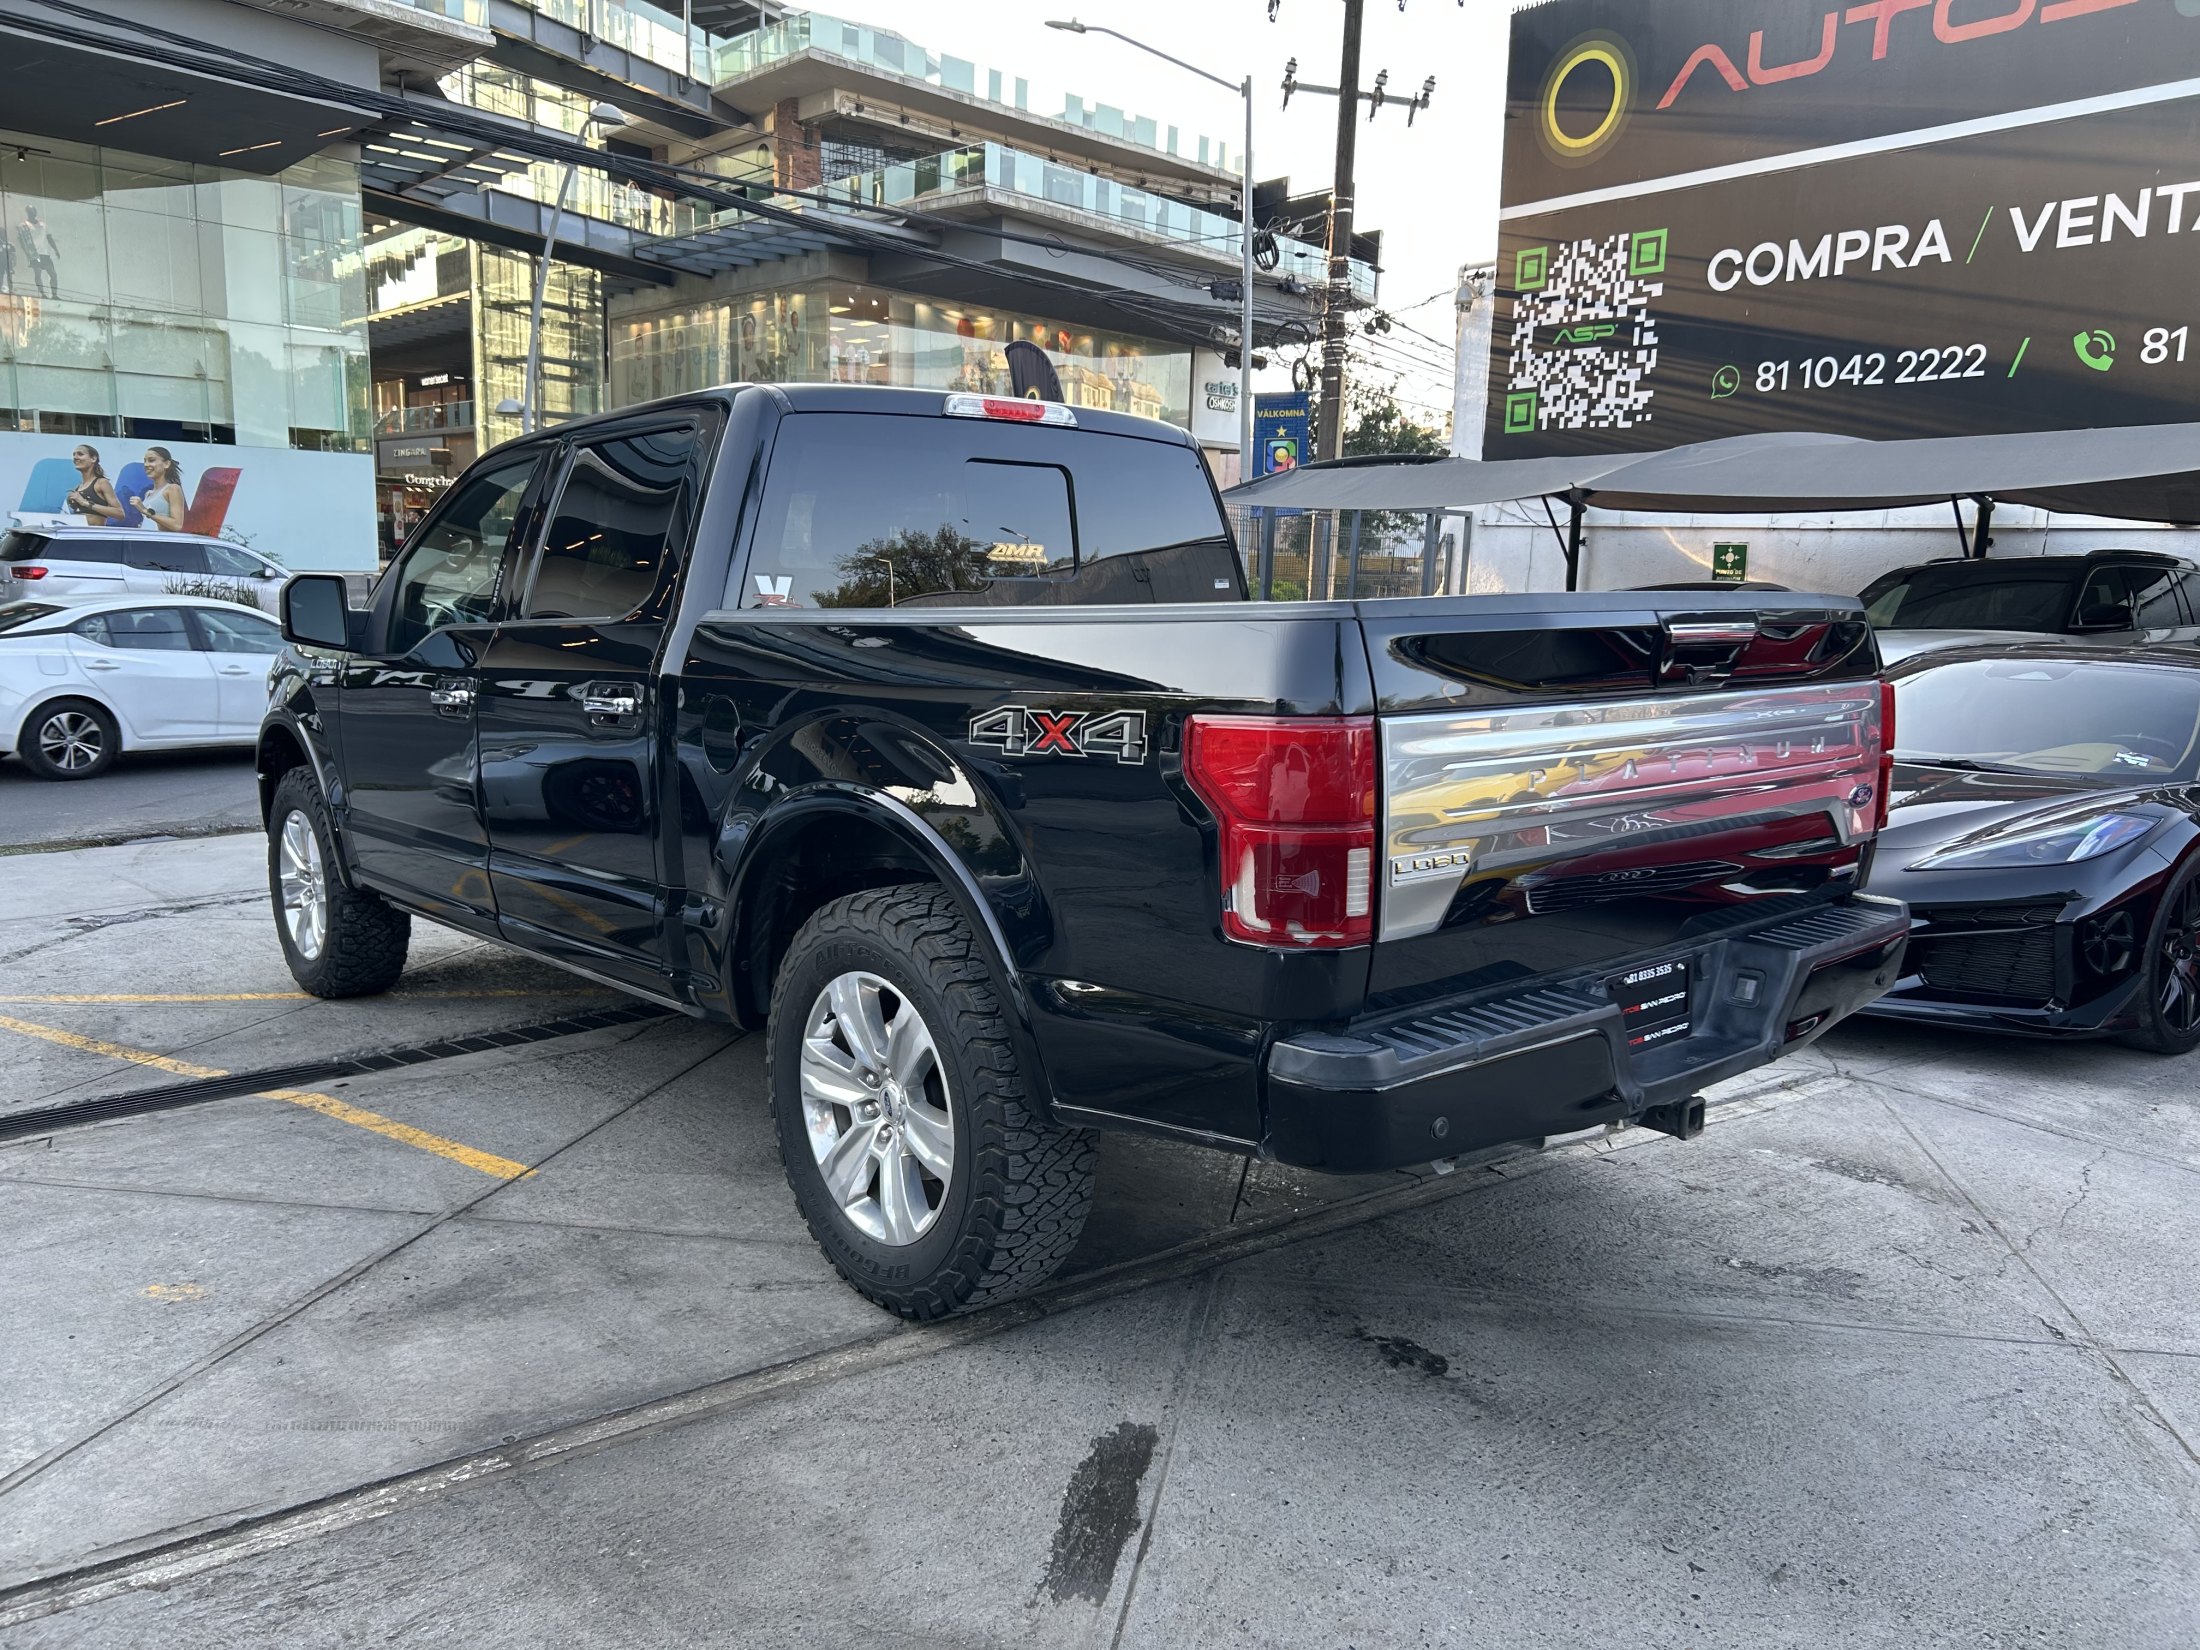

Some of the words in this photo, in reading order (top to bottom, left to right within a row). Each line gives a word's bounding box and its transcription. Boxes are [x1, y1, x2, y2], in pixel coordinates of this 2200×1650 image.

[1706, 218, 1953, 292] COMPRA
[1755, 360, 1790, 393] 81
[1799, 352, 1885, 389] 1042
[1894, 343, 1988, 384] 2222
[2139, 326, 2190, 365] 81
[1257, 409, 1306, 418] VÄLKOMNA
[1528, 736, 1826, 792] PLATINUM
